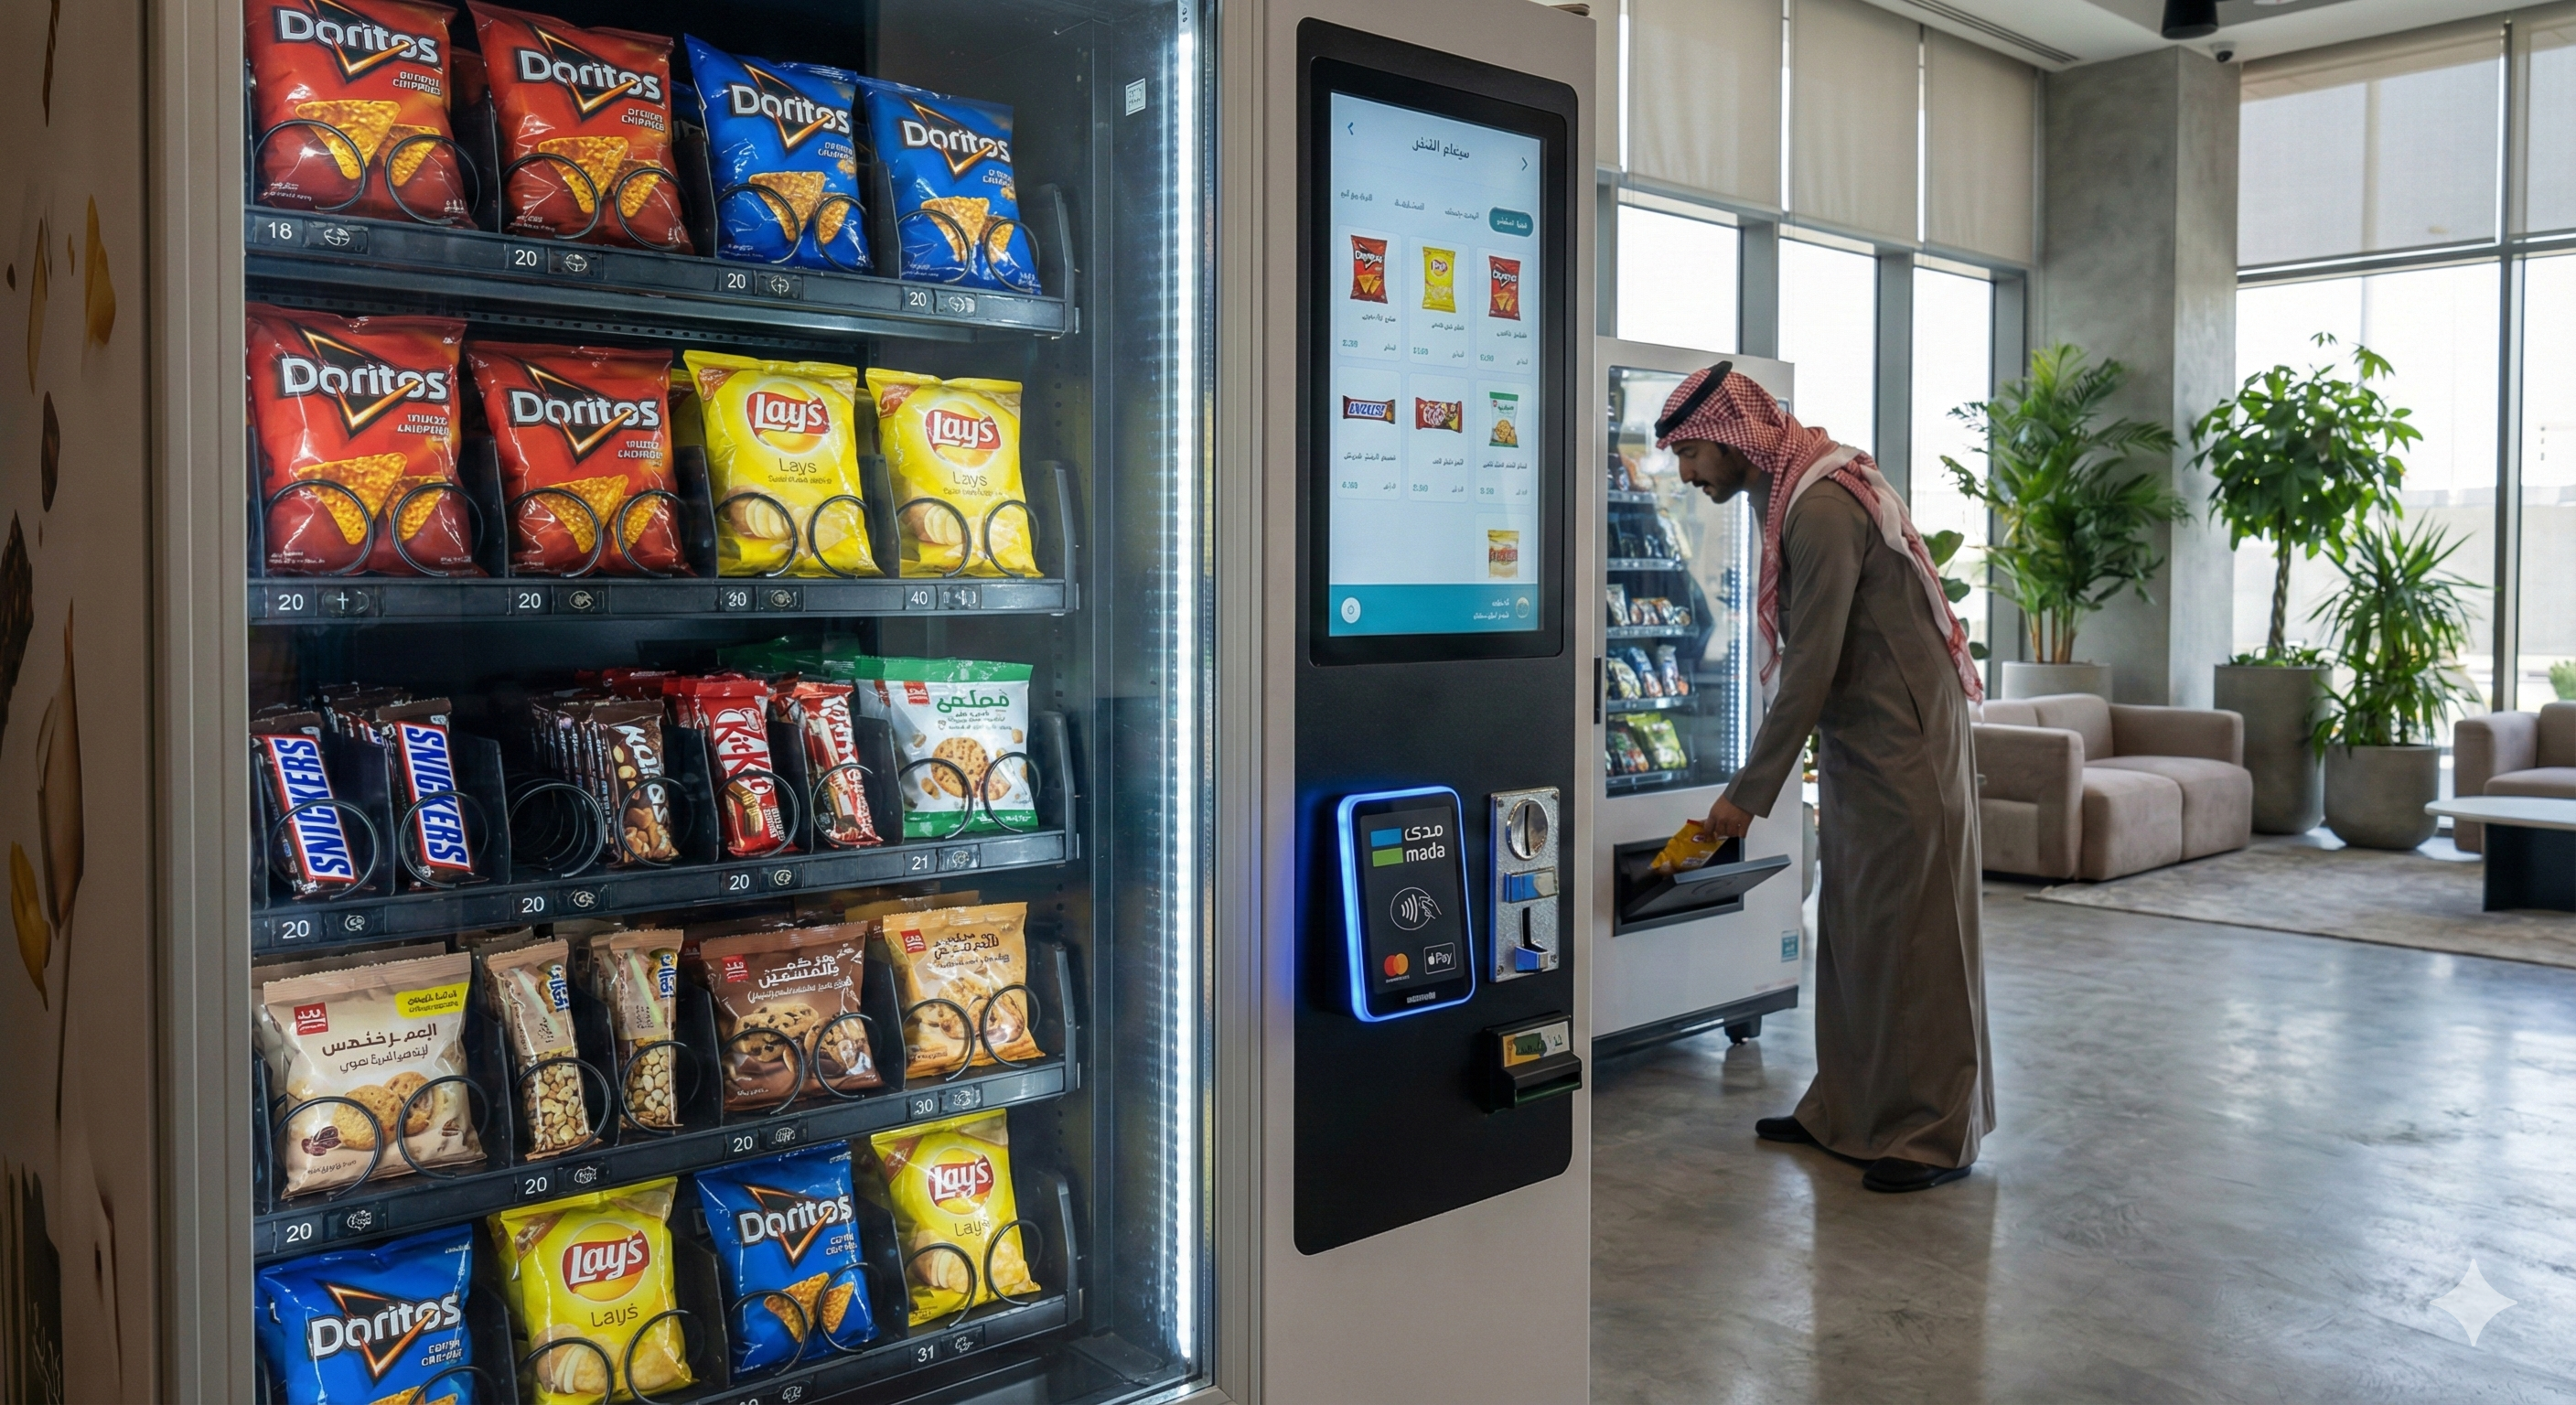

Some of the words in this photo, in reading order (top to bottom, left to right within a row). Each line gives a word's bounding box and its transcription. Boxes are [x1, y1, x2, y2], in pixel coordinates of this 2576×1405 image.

[277, 8, 440, 65] Doritos
[519, 48, 661, 101] Doritos
[732, 84, 850, 134] Doritos
[902, 120, 1011, 162] Doritos
[266, 221, 294, 241] 18
[515, 250, 538, 266] 20
[727, 273, 746, 290] 20
[909, 292, 927, 307] 20
[282, 358, 449, 401] Doritos
[510, 390, 661, 427] Doritos
[754, 393, 823, 434] Lay's
[932, 409, 995, 449] Lay's
[778, 457, 817, 477] Lays
[278, 594, 305, 612] 20
[518, 593, 542, 609] 20
[910, 590, 928, 606] 40
[406, 727, 468, 865] SNICKERS
[274, 738, 353, 877] SNICKERS
[911, 854, 928, 871] 21
[1406, 842, 1445, 863] mada
[728, 874, 750, 891] 20
[521, 896, 545, 914] 20
[282, 920, 310, 939] 20
[1435, 951, 1453, 966] Pay
[916, 1098, 934, 1114] 30
[734, 1136, 754, 1153] 20
[525, 1177, 548, 1195] 20
[934, 1159, 991, 1201] Lay's
[738, 1194, 853, 1246] Doritos
[286, 1222, 313, 1243] 20
[569, 1235, 644, 1286] Lay's
[311, 1294, 461, 1358] Doritos
[918, 1345, 936, 1363] 31
